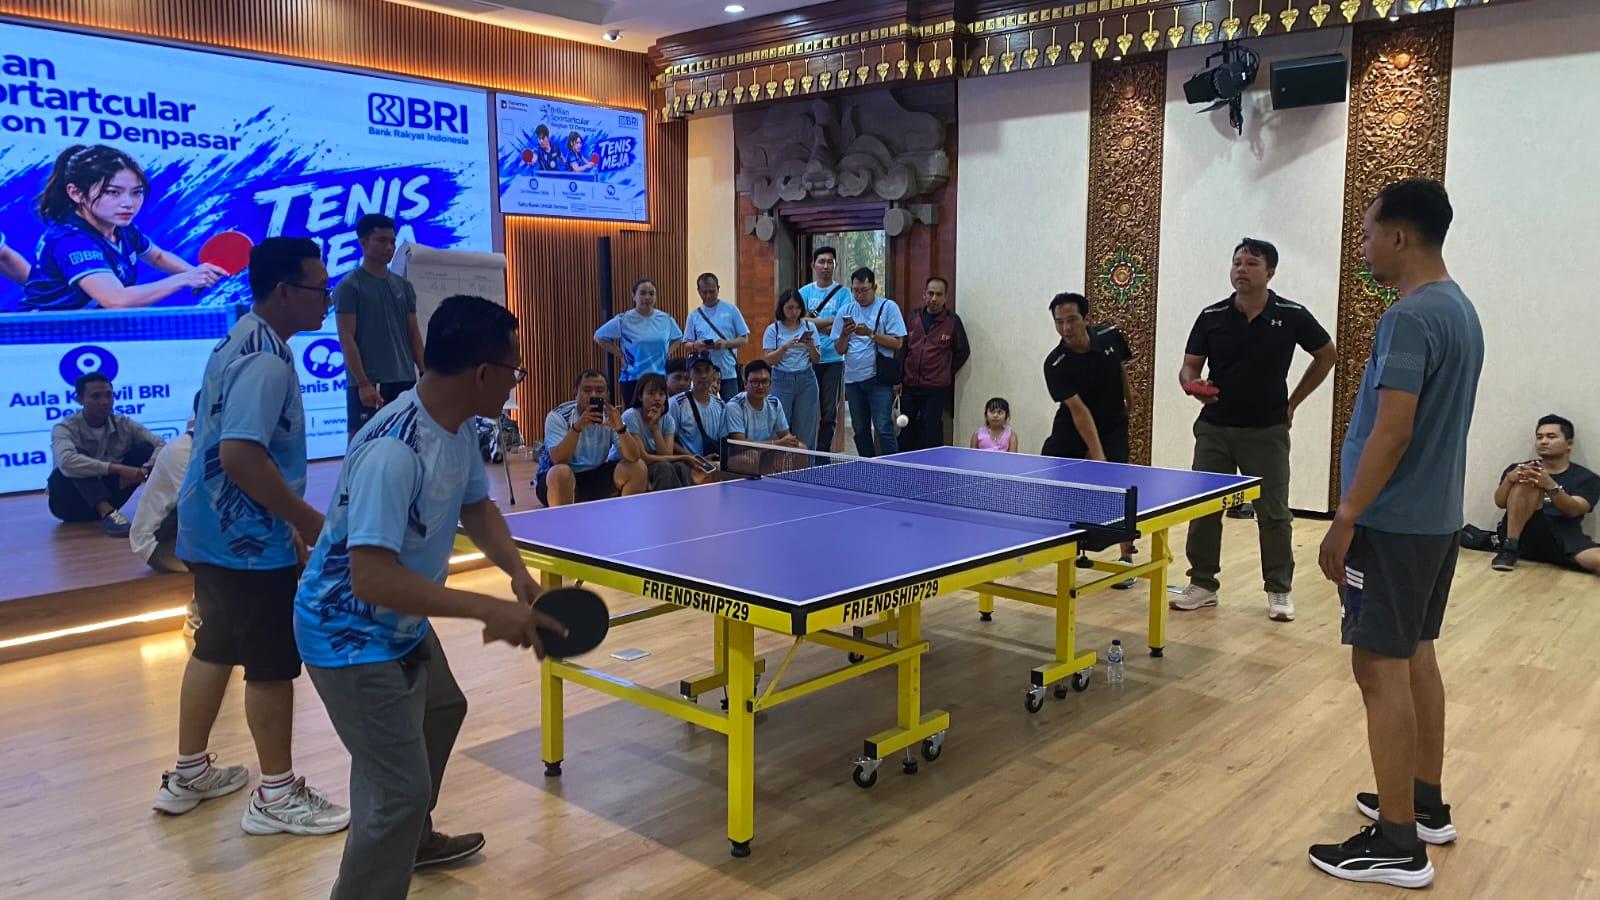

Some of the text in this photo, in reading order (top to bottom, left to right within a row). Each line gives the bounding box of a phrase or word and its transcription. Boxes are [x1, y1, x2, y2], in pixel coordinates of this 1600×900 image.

[408, 97, 468, 134] BRI
[54, 116, 90, 137] 17
[99, 119, 242, 151] Denpasar
[368, 127, 469, 145] Bank Rakyat Indonesia
[598, 139, 631, 158] TENIS
[601, 153, 630, 170] MEJA
[253, 175, 430, 238] TENIS
[9, 391, 60, 408] Aula
[139, 384, 170, 399] BRI
[300, 381, 329, 393] enis
[46, 403, 145, 420] Desar
[642, 580, 750, 621] FRIENDSHIP729
[842, 579, 938, 624] FRIENDSHIP729
